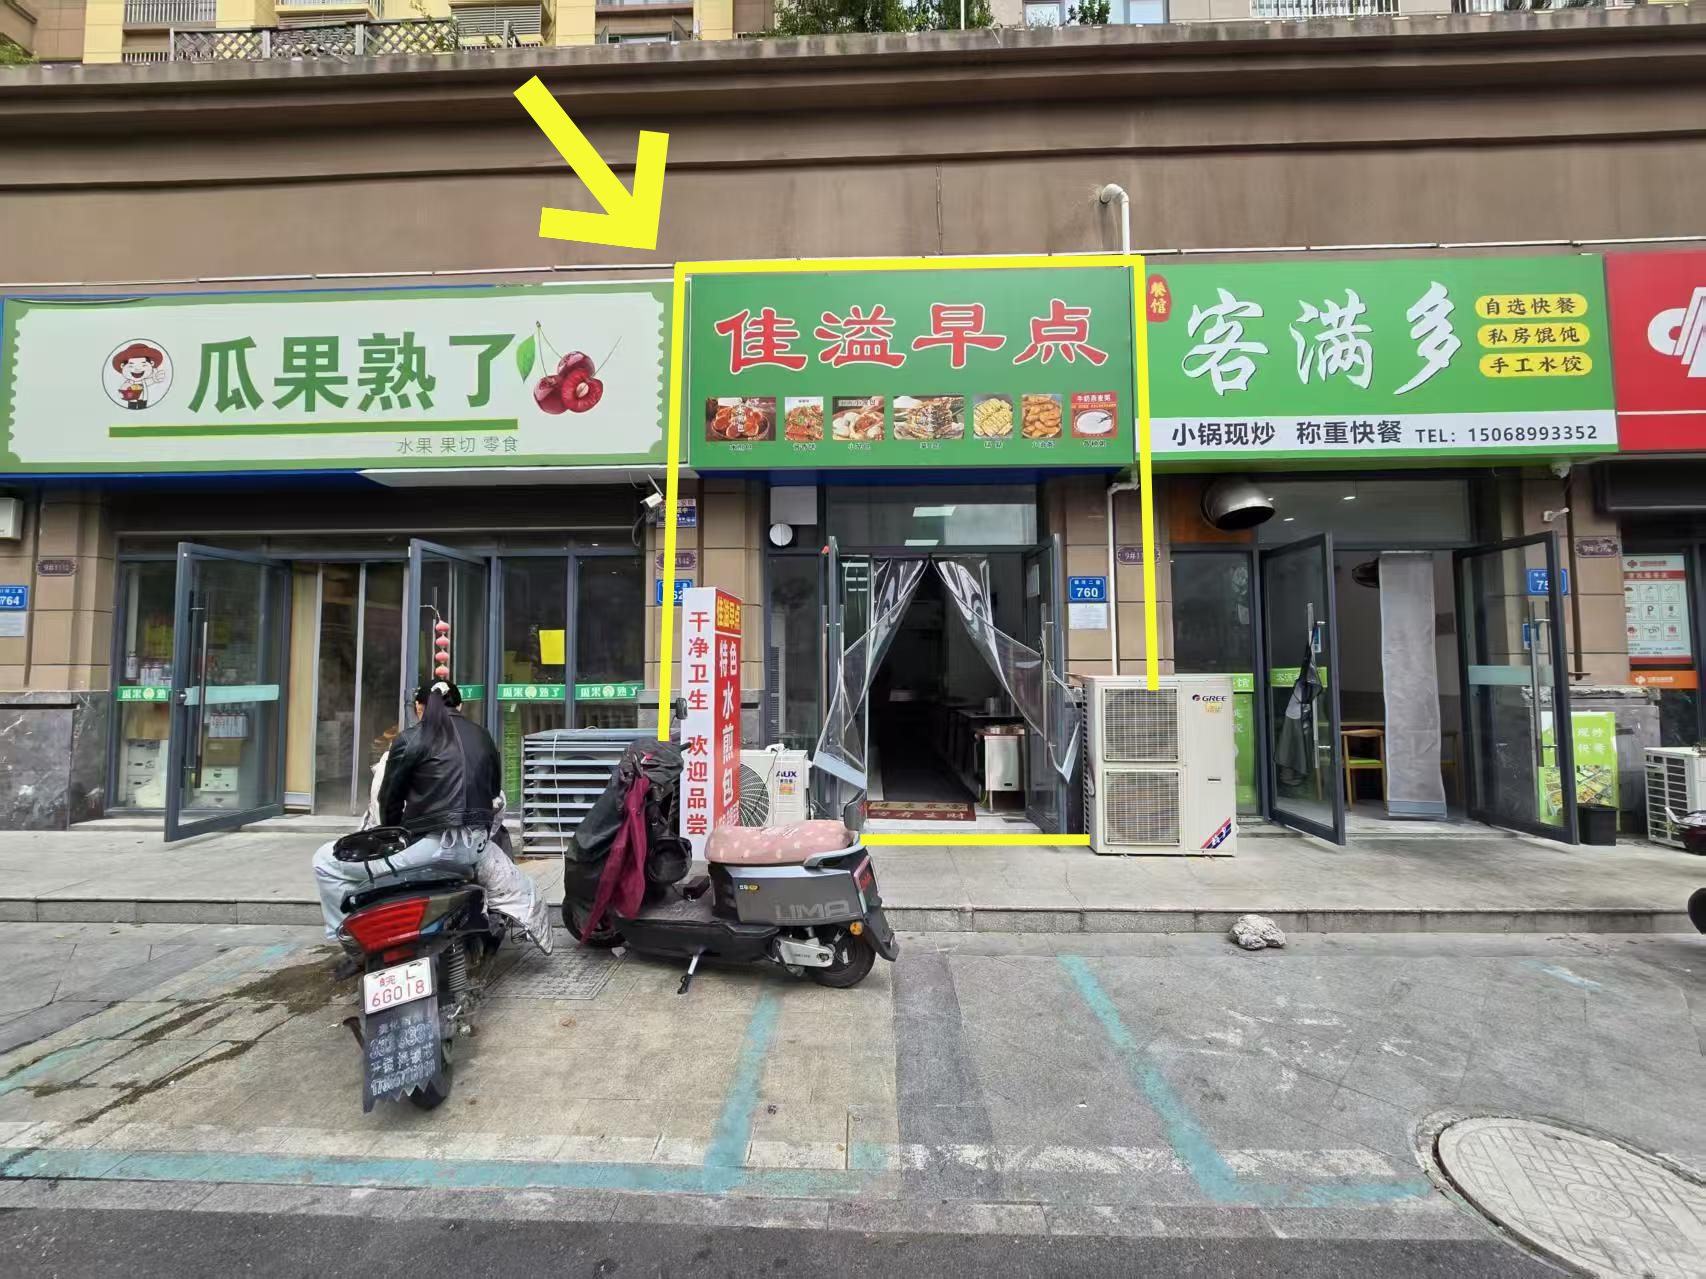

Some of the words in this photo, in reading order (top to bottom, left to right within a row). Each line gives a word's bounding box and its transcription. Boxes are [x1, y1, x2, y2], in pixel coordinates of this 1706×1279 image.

[1150, 281, 1168, 314] 餐馆
[1486, 297, 1577, 315] 自选快餐
[714, 298, 1110, 375] 佳溢早点
[1181, 280, 1462, 396] 客满多
[1488, 328, 1581, 344] 私房馄饨
[188, 331, 516, 413] 瓜果熟了
[1490, 355, 1584, 374] 手工水饺
[397, 437, 433, 455] 水果
[439, 436, 476, 454] 果切
[483, 436, 519, 453] 零食
[1172, 422, 1276, 447] 小锅现炒
[1296, 419, 1402, 445] 称重快餐
[1468, 425, 1598, 442] 15068993352
[1076, 587, 1099, 598] 760
[687, 611, 710, 711] 干净卫生
[719, 639, 738, 678] 特色
[722, 680, 735, 808] 水煎包
[686, 734, 709, 836] 欢迎品尝
[371, 979, 425, 1007] 6G018
